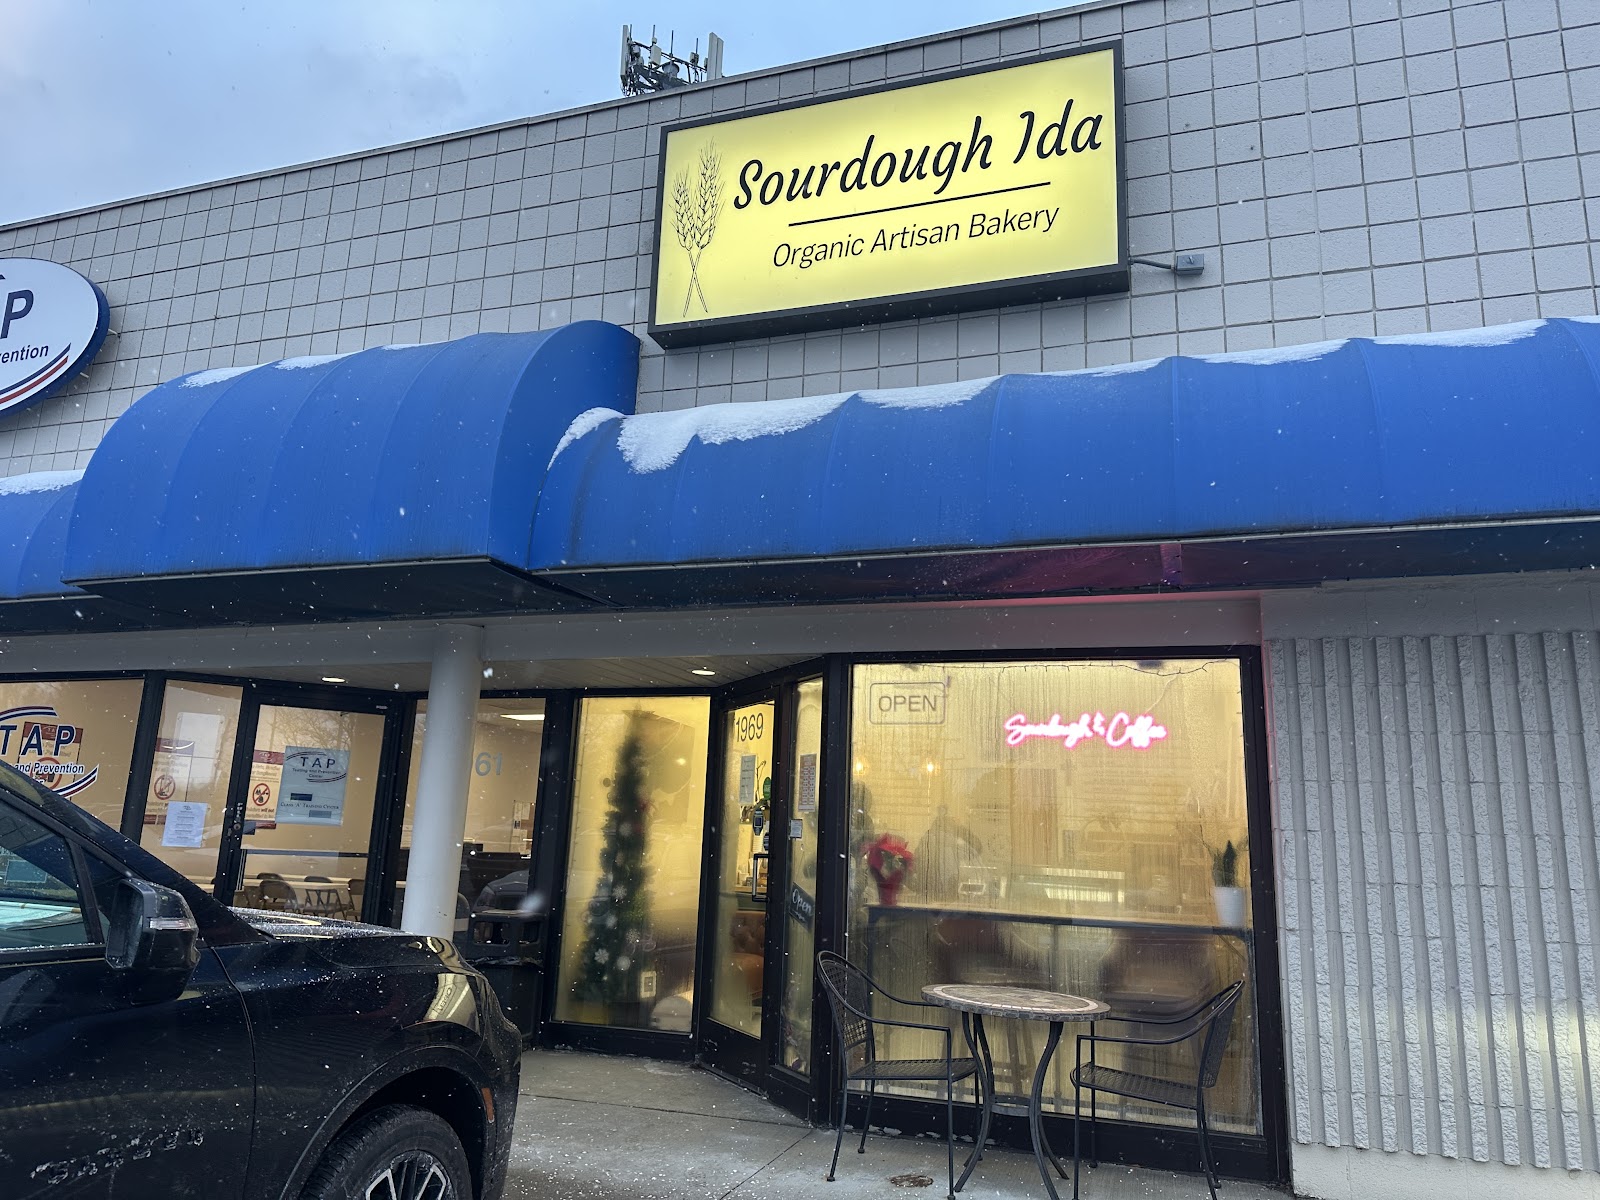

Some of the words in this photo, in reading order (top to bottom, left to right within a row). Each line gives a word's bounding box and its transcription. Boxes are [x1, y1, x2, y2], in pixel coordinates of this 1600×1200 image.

[733, 115, 993, 210] Sourdough
[1012, 98, 1103, 164] Ida
[773, 233, 865, 269] Organic
[870, 219, 959, 253] Artisan
[968, 207, 1060, 239] Bakery
[878, 694, 937, 713] OPEN
[0, 724, 76, 757] TAP
[735, 712, 765, 743] 1969
[33, 762, 84, 774] Prevention
[300, 757, 336, 768] TAP
[792, 888, 813, 915] Open
